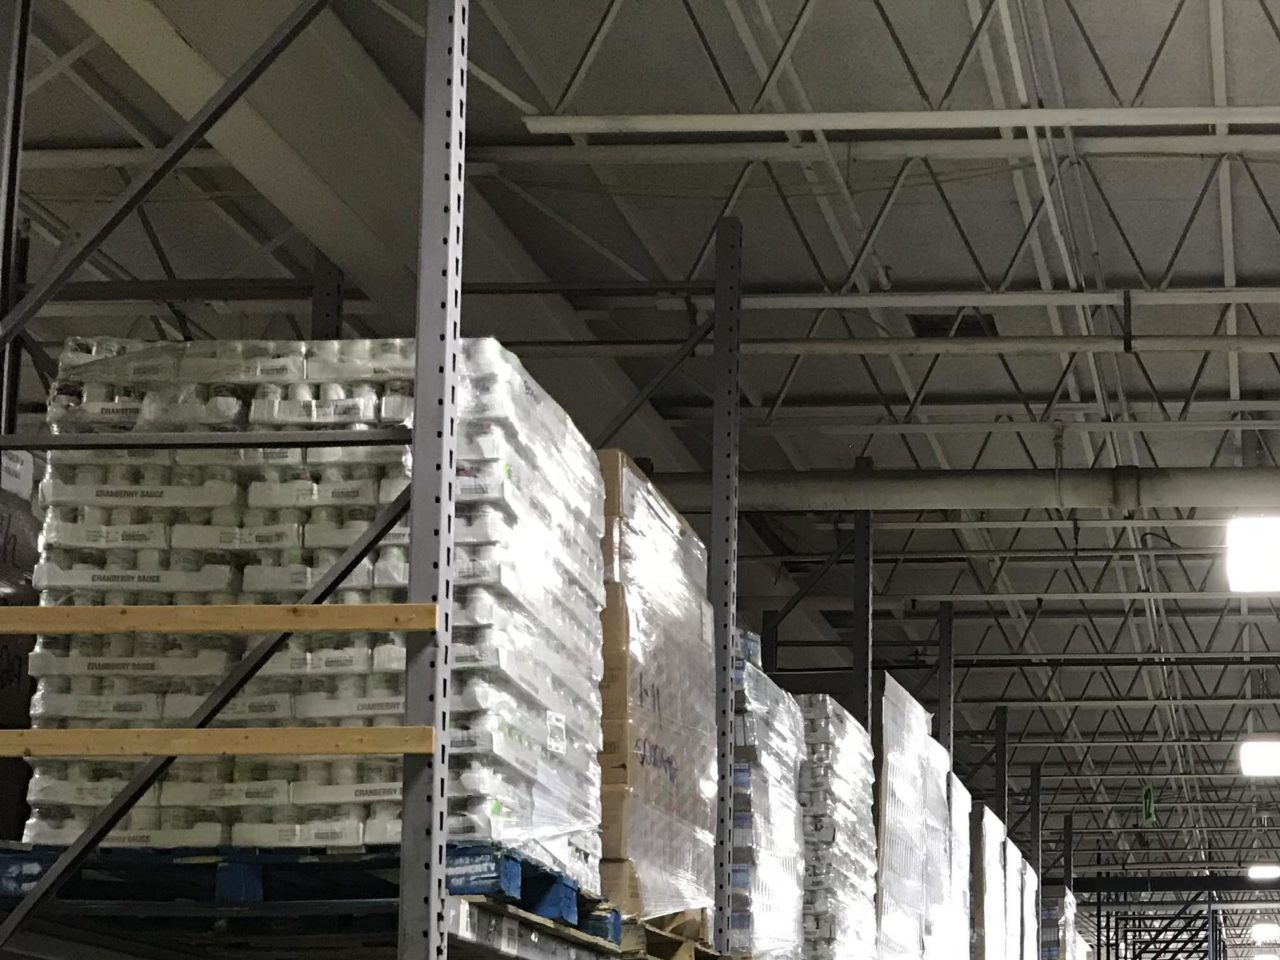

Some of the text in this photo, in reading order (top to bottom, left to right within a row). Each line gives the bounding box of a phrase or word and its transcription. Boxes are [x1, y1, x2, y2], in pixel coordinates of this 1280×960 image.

[100, 407, 140, 416] CRANBERR
[95, 489, 164, 498] CRANBERRY SAUCE
[91, 574, 161, 583] CRANBERRY SAUCE
[354, 788, 398, 798] CRANBERRY
